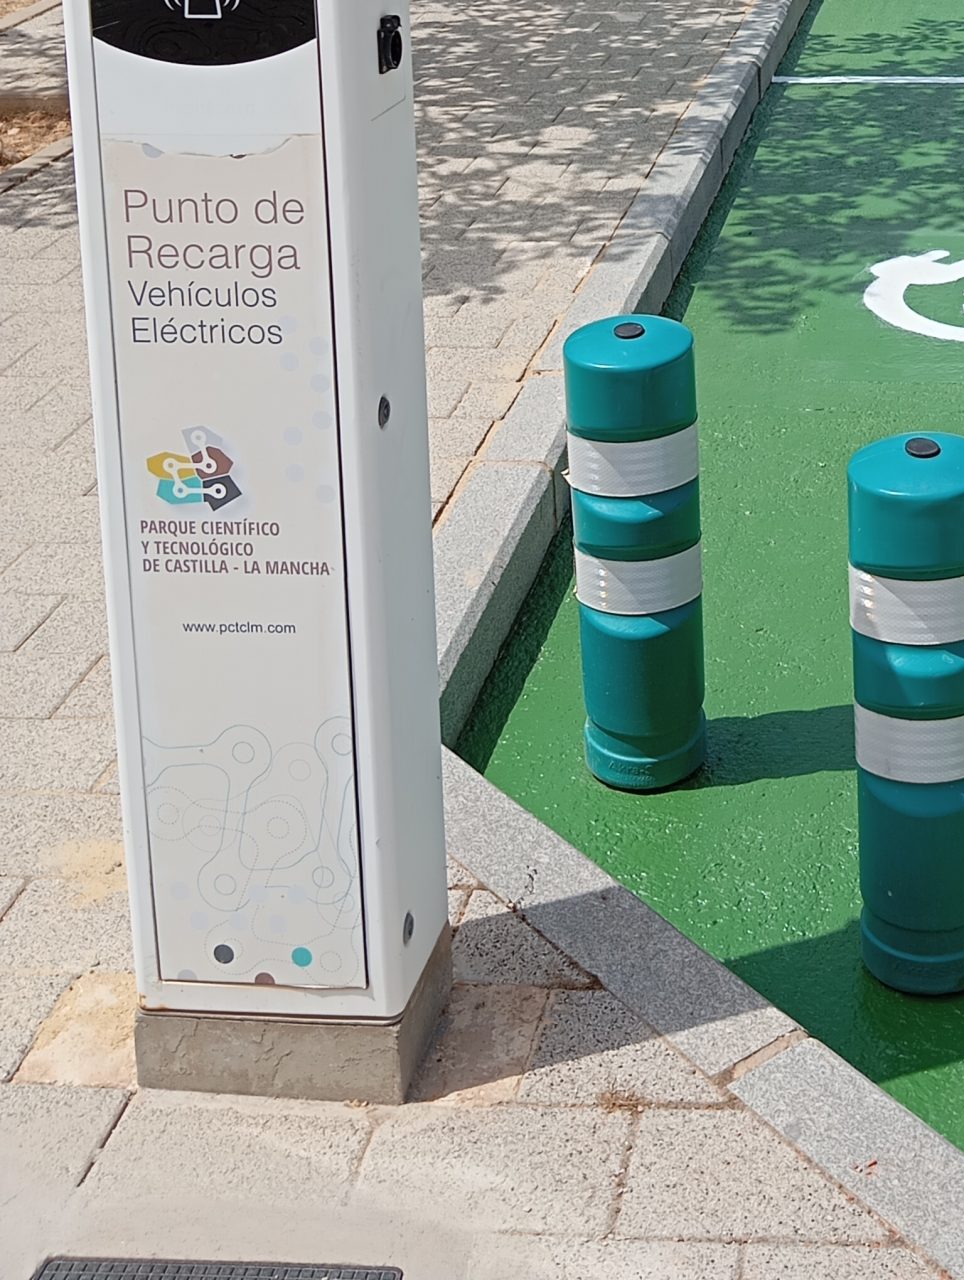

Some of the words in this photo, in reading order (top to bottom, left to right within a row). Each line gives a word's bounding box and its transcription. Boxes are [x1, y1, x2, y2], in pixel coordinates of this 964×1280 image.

[124, 189, 238, 224] Punto
[254, 190, 304, 224] de
[127, 235, 301, 279] Recarga
[128, 280, 277, 307] Vehículos
[132, 317, 283, 344] Eléctricos
[140, 520, 196, 537] PARQUE
[201, 518, 280, 536] CIENTÍFICO
[141, 541, 149, 554] Y
[154, 538, 254, 556] TECNOLÓGICO
[143, 558, 160, 572] DE
[165, 559, 229, 574] CASTILLA
[244, 560, 261, 574] LA
[265, 561, 330, 576] MANCHA
[182, 622, 296, 635] www.pctclm.com
